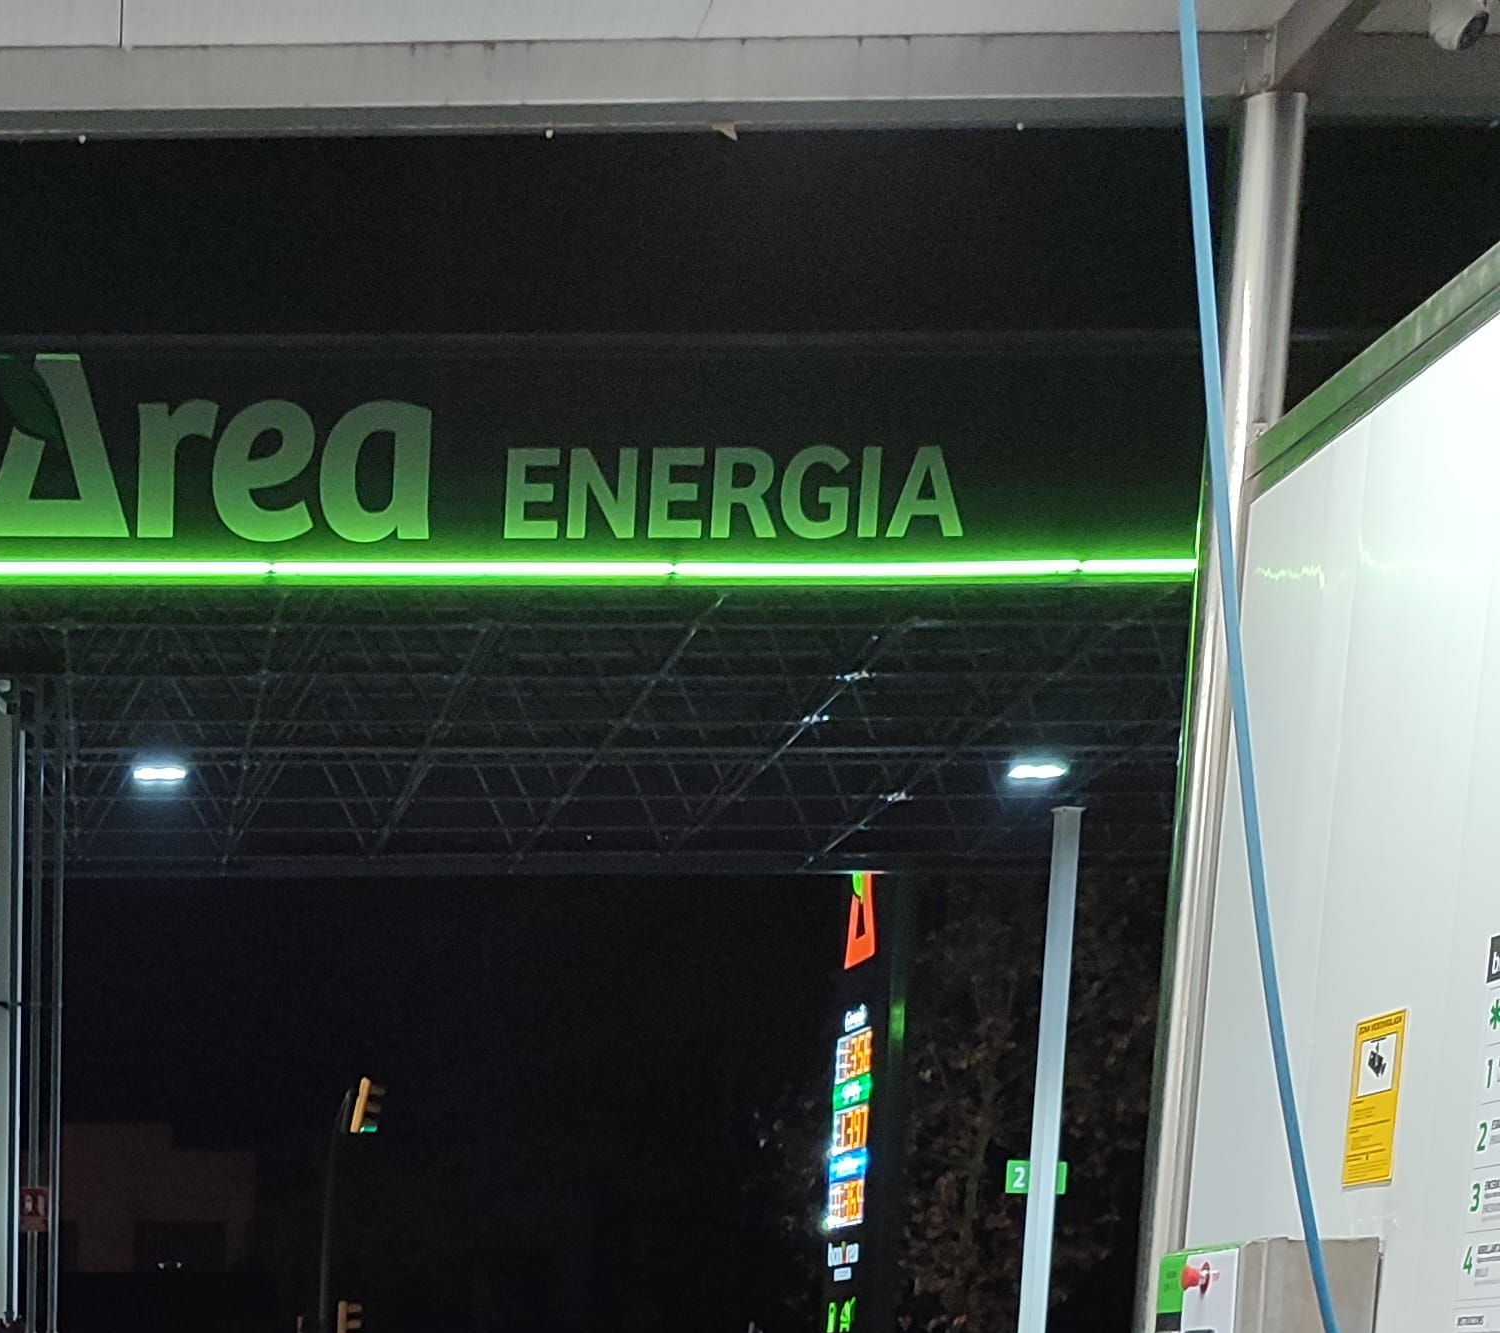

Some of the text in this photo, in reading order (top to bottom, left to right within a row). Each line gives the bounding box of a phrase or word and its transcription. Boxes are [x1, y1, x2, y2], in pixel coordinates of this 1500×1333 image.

[503, 444, 965, 540] ENERGIA
[1476, 1122, 1488, 1151] 2
[1012, 1166, 1026, 1188] 2
[1470, 1183, 1481, 1212] 3
[1463, 1246, 1473, 1274] 4
